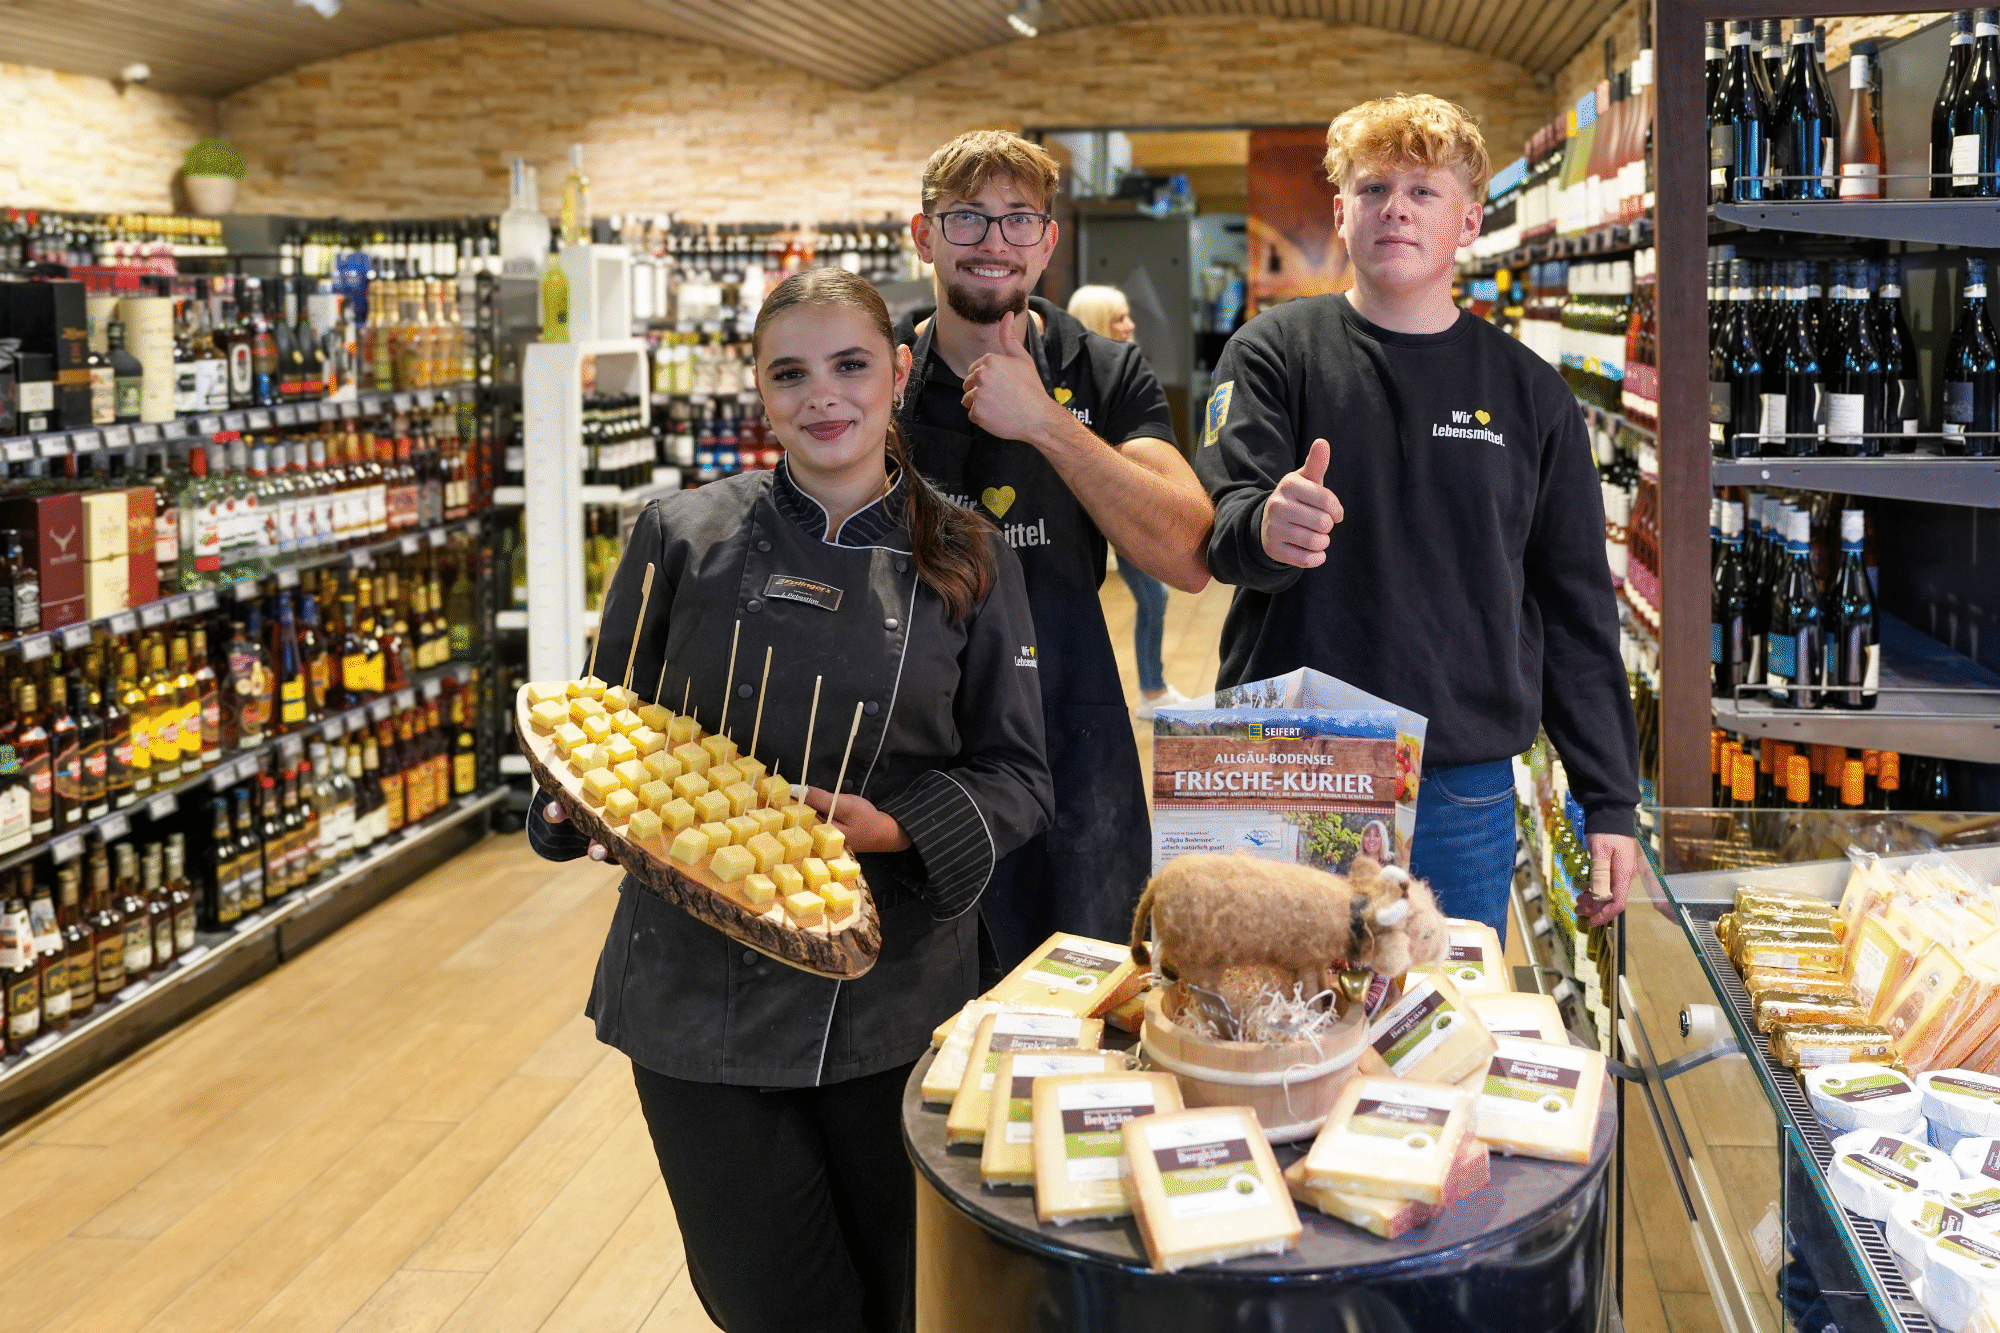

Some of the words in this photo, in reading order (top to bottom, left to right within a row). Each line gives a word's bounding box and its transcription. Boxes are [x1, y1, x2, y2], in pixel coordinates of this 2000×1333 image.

[1452, 410, 1473, 424] Wir
[1432, 423, 1506, 447] Lebensmittel.
[1264, 727, 1301, 737] SEIFERT
[1214, 750, 1334, 766] ALLGÄU-BODENSEE
[1174, 771, 1374, 794] FRISCHE-KURIER
